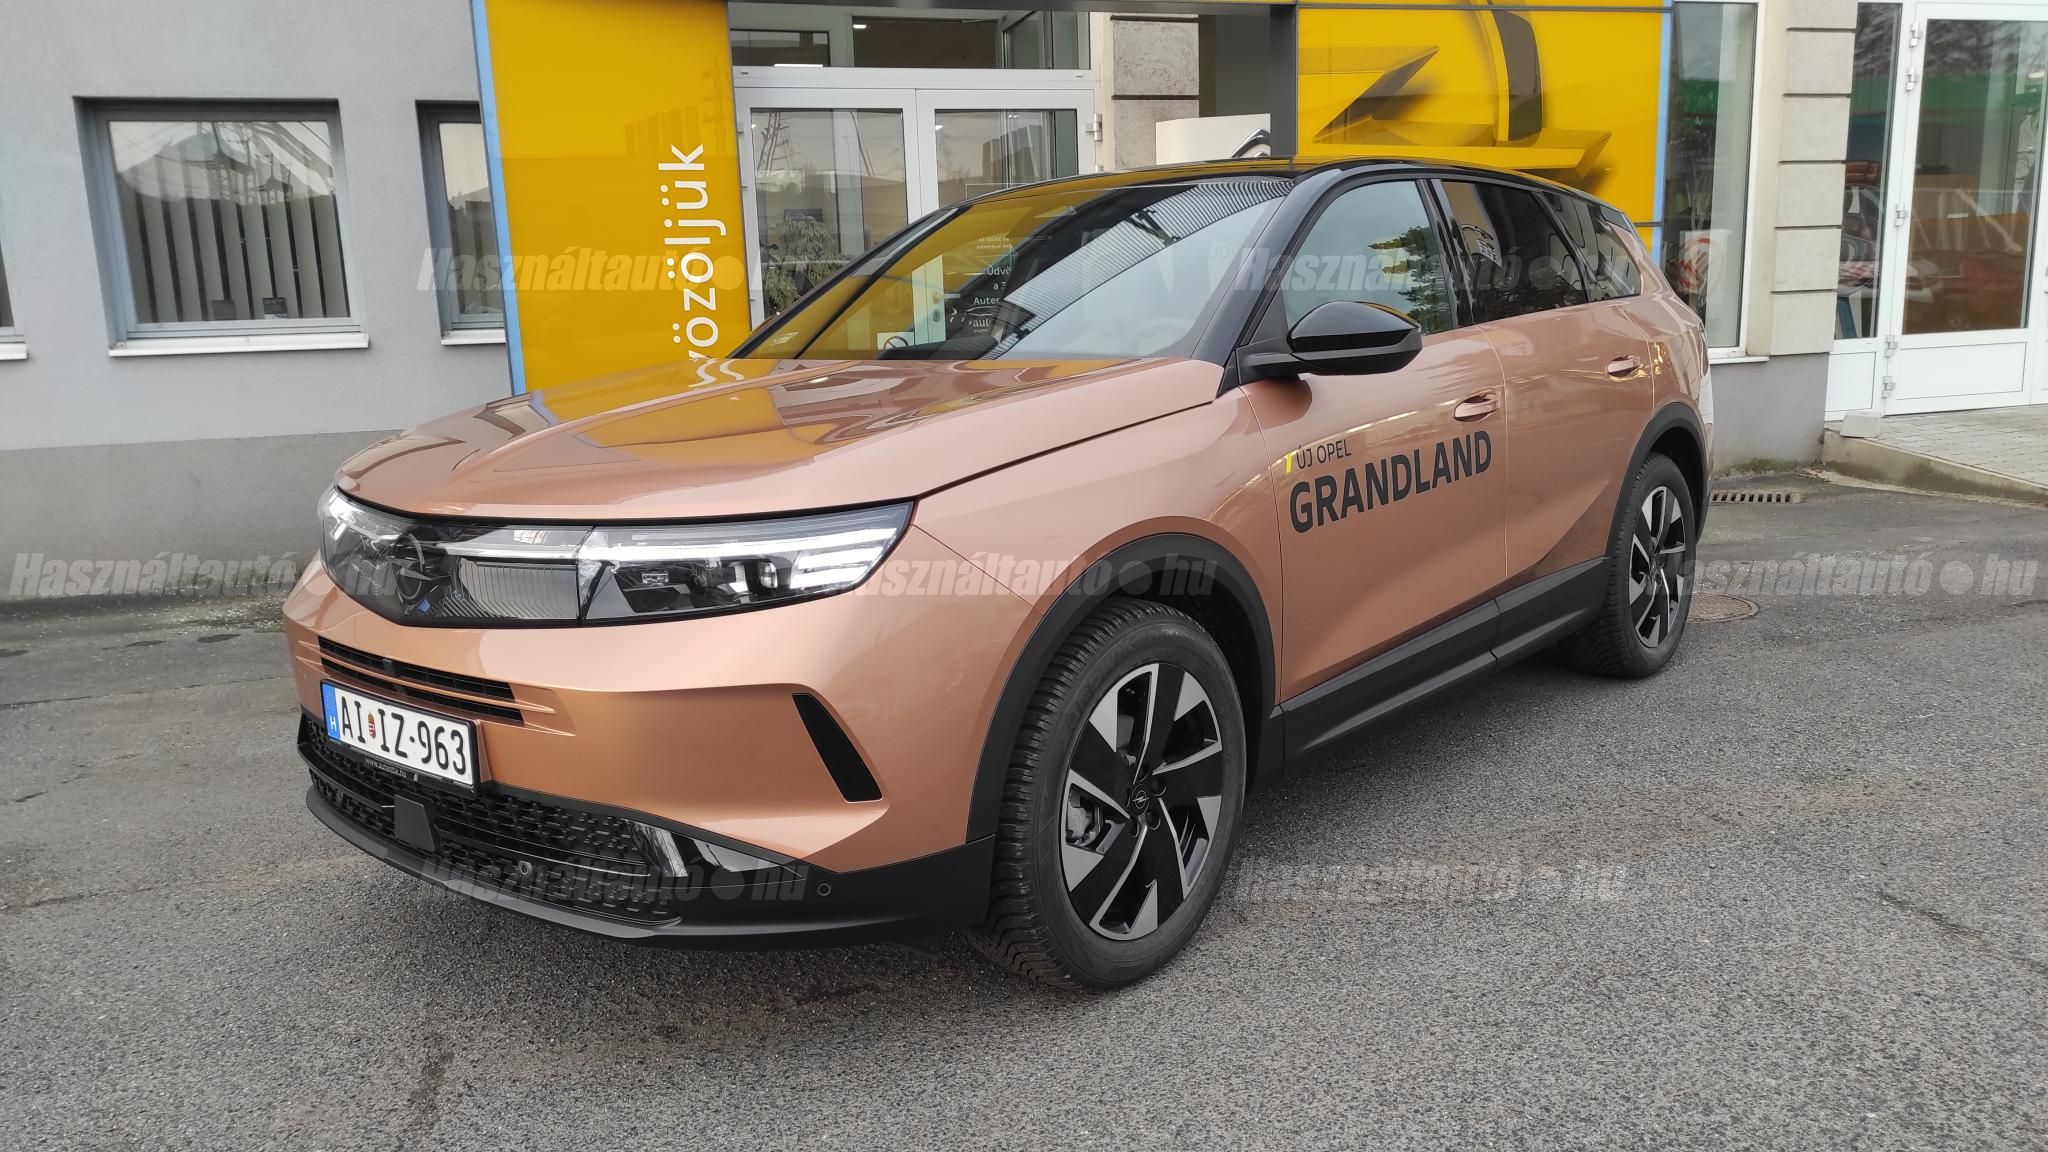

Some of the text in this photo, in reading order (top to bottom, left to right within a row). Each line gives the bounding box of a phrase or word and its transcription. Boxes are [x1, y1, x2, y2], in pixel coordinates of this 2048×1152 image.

[658, 144, 726, 359] özöljük
[1290, 430, 1492, 534] GRANDLAND
[1296, 439, 1352, 470] ÚJ OPEL
[330, 716, 337, 731] H
[341, 695, 366, 744] AI
